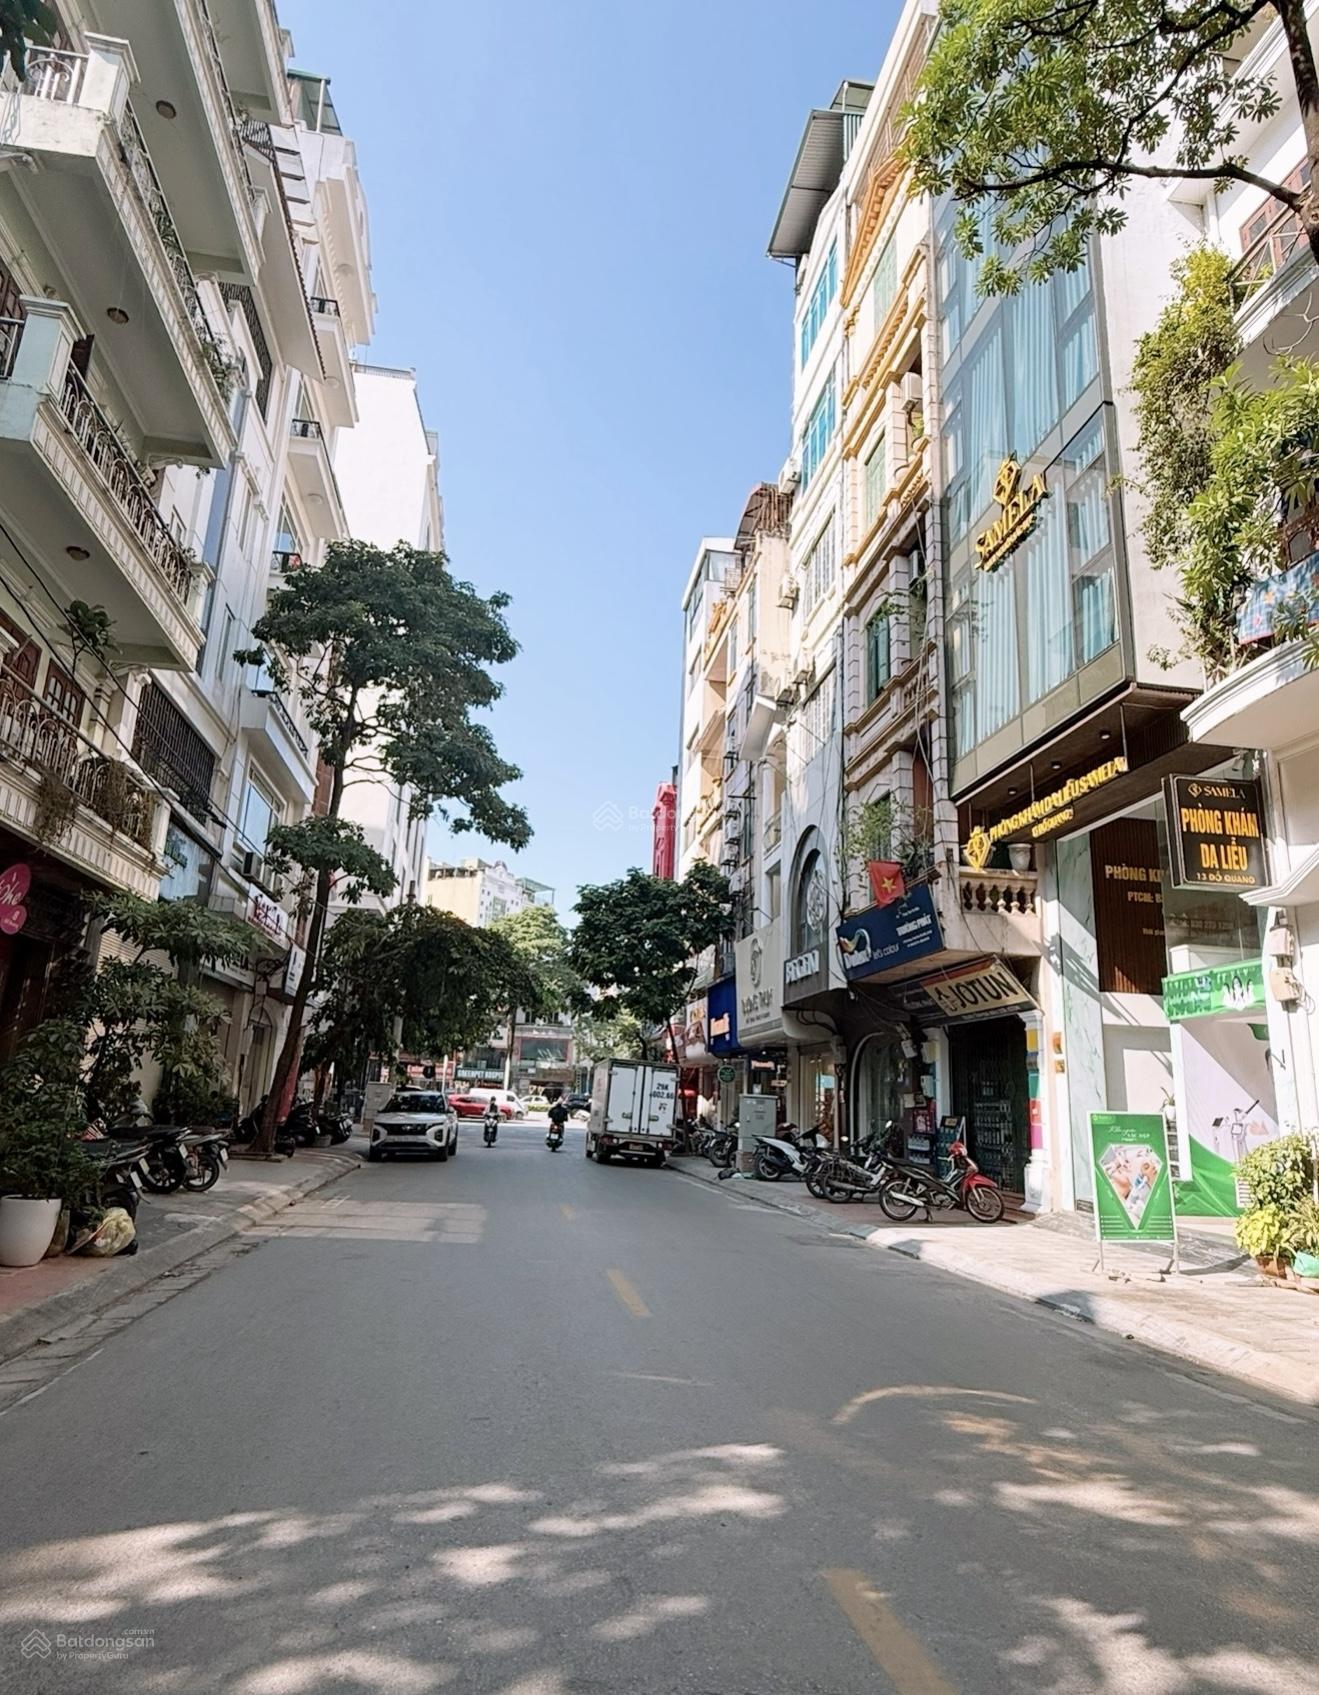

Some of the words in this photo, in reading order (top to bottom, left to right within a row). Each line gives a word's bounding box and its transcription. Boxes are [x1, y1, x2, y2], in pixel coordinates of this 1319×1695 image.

[1204, 786, 1246, 799] SAMELA
[1181, 803, 1222, 834] PHÒNG
[1224, 807, 1259, 838] KHÁM
[1200, 843, 1219, 869] DA
[1221, 837, 1248, 871] LIỄU
[1105, 863, 1146, 880] PHÒNG
[948, 972, 1018, 1008] JOTUN
